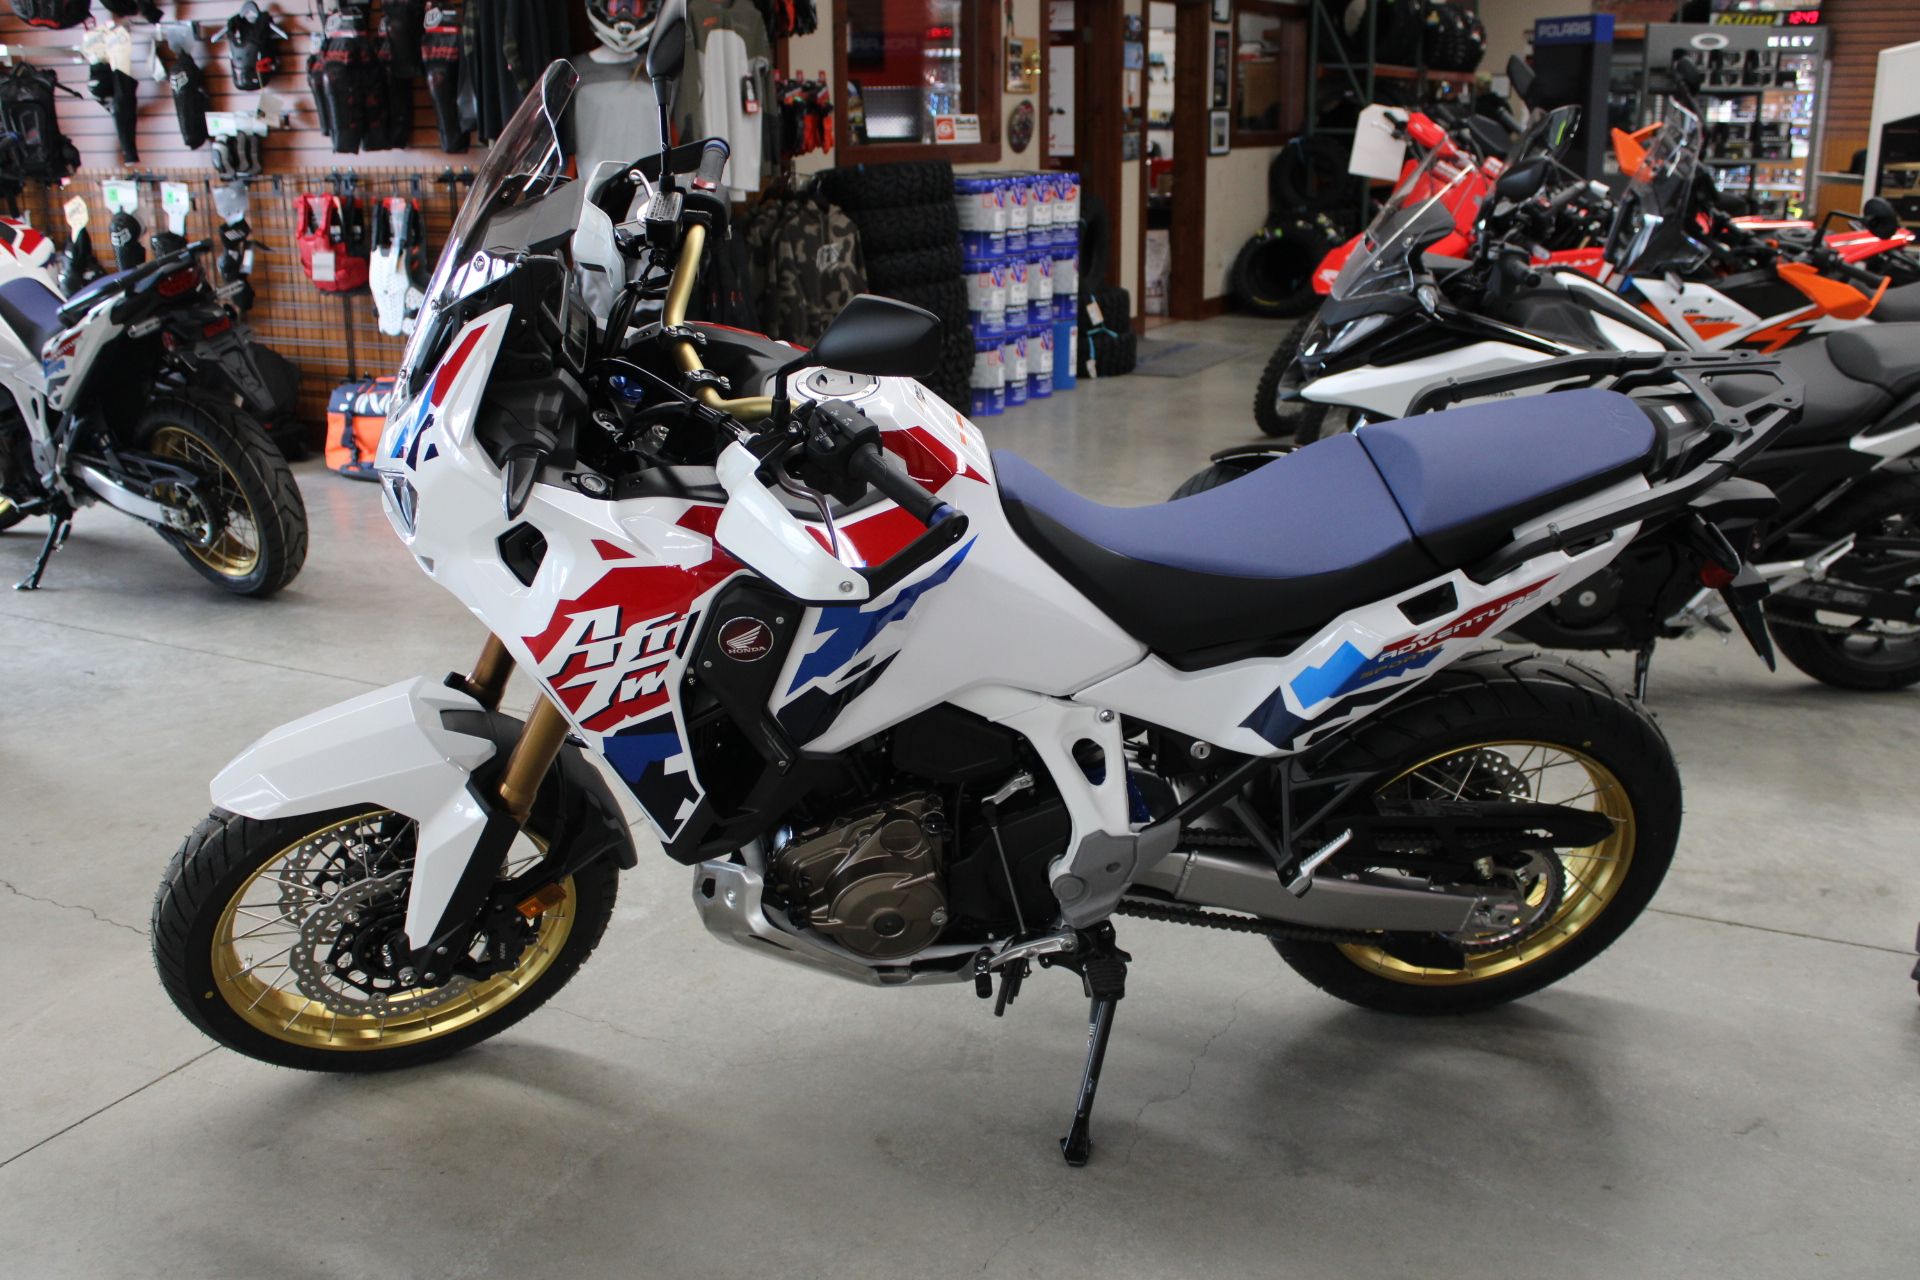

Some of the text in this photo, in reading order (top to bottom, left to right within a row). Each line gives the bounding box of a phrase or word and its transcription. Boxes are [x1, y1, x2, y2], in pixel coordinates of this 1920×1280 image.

[1538, 20, 1592, 37] POLARIS
[1053, 178, 1074, 201] VP
[1378, 589, 1542, 663] ADVENTURE
[728, 645, 767, 655] HONDA
[1360, 644, 1443, 680] SPORTS
